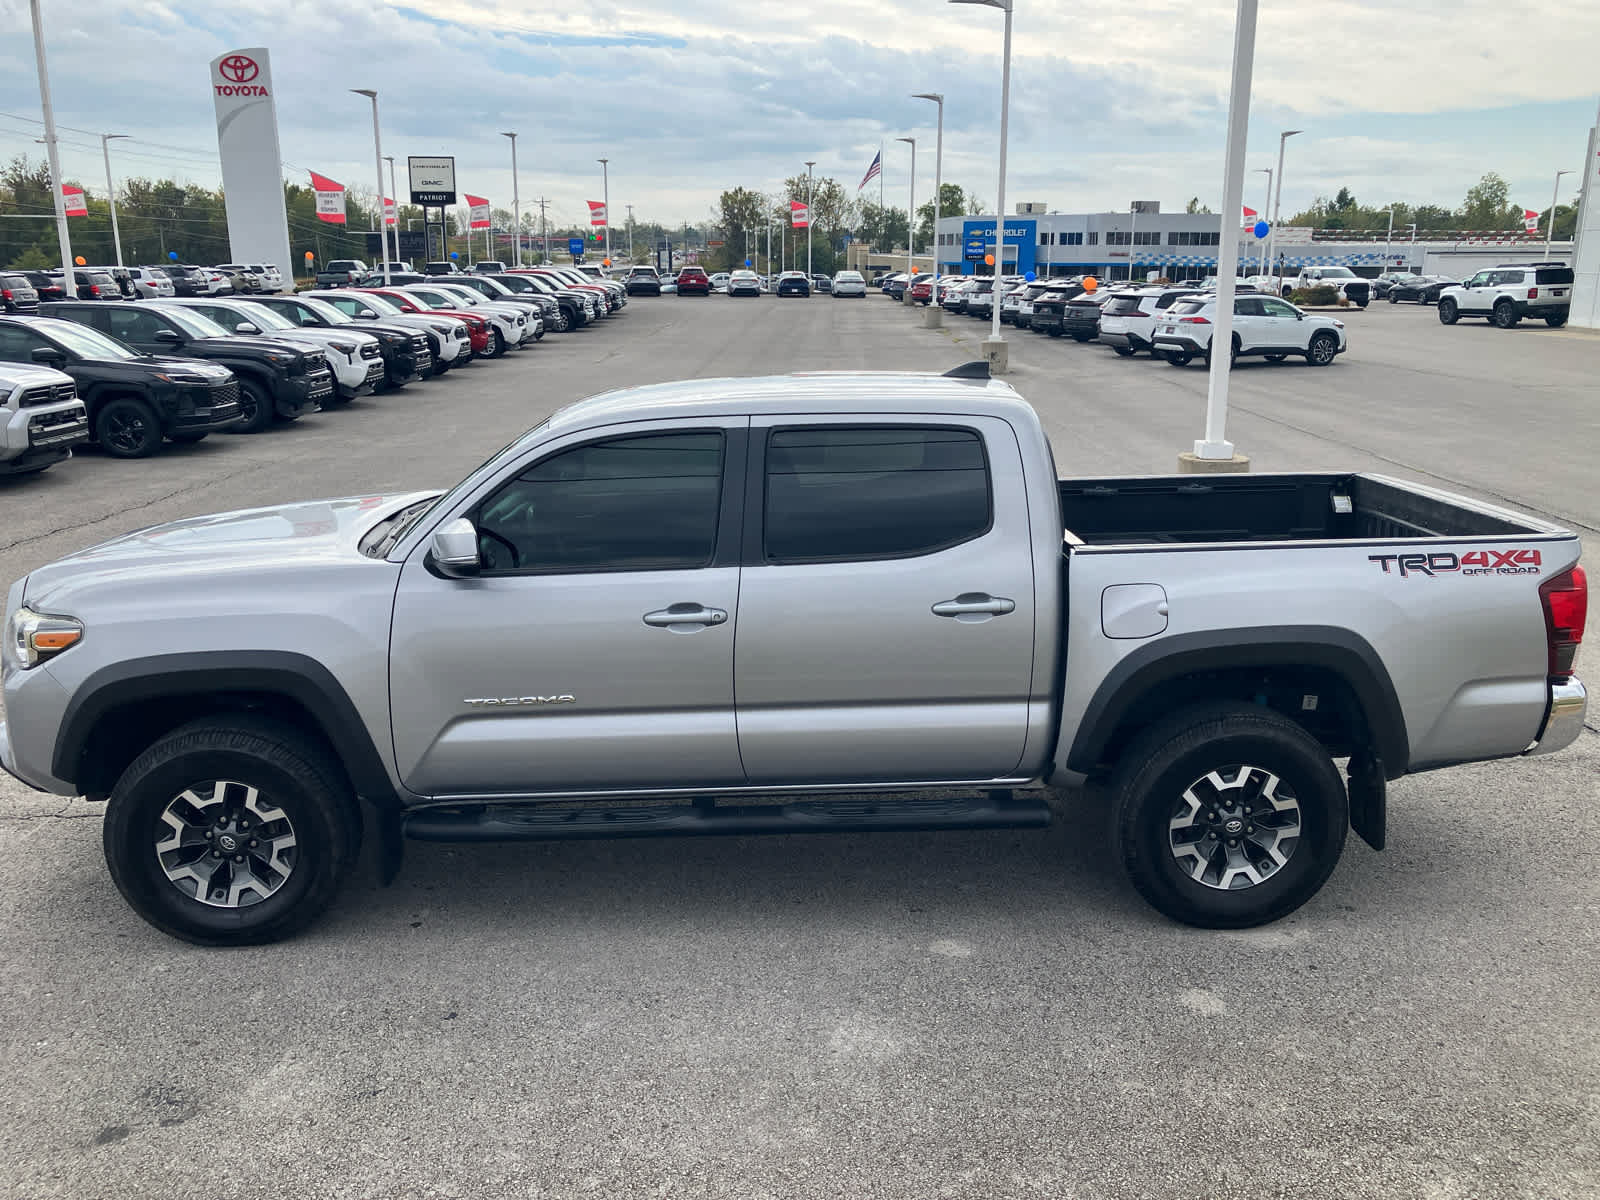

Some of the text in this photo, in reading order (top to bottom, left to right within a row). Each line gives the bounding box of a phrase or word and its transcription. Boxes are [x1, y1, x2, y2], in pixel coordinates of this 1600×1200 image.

[215, 85, 269, 97] TOYOTA
[1368, 549, 1542, 579] TRD 4X4
[1462, 566, 1541, 577] OFF ROAD
[463, 694, 576, 705] TACOMA
